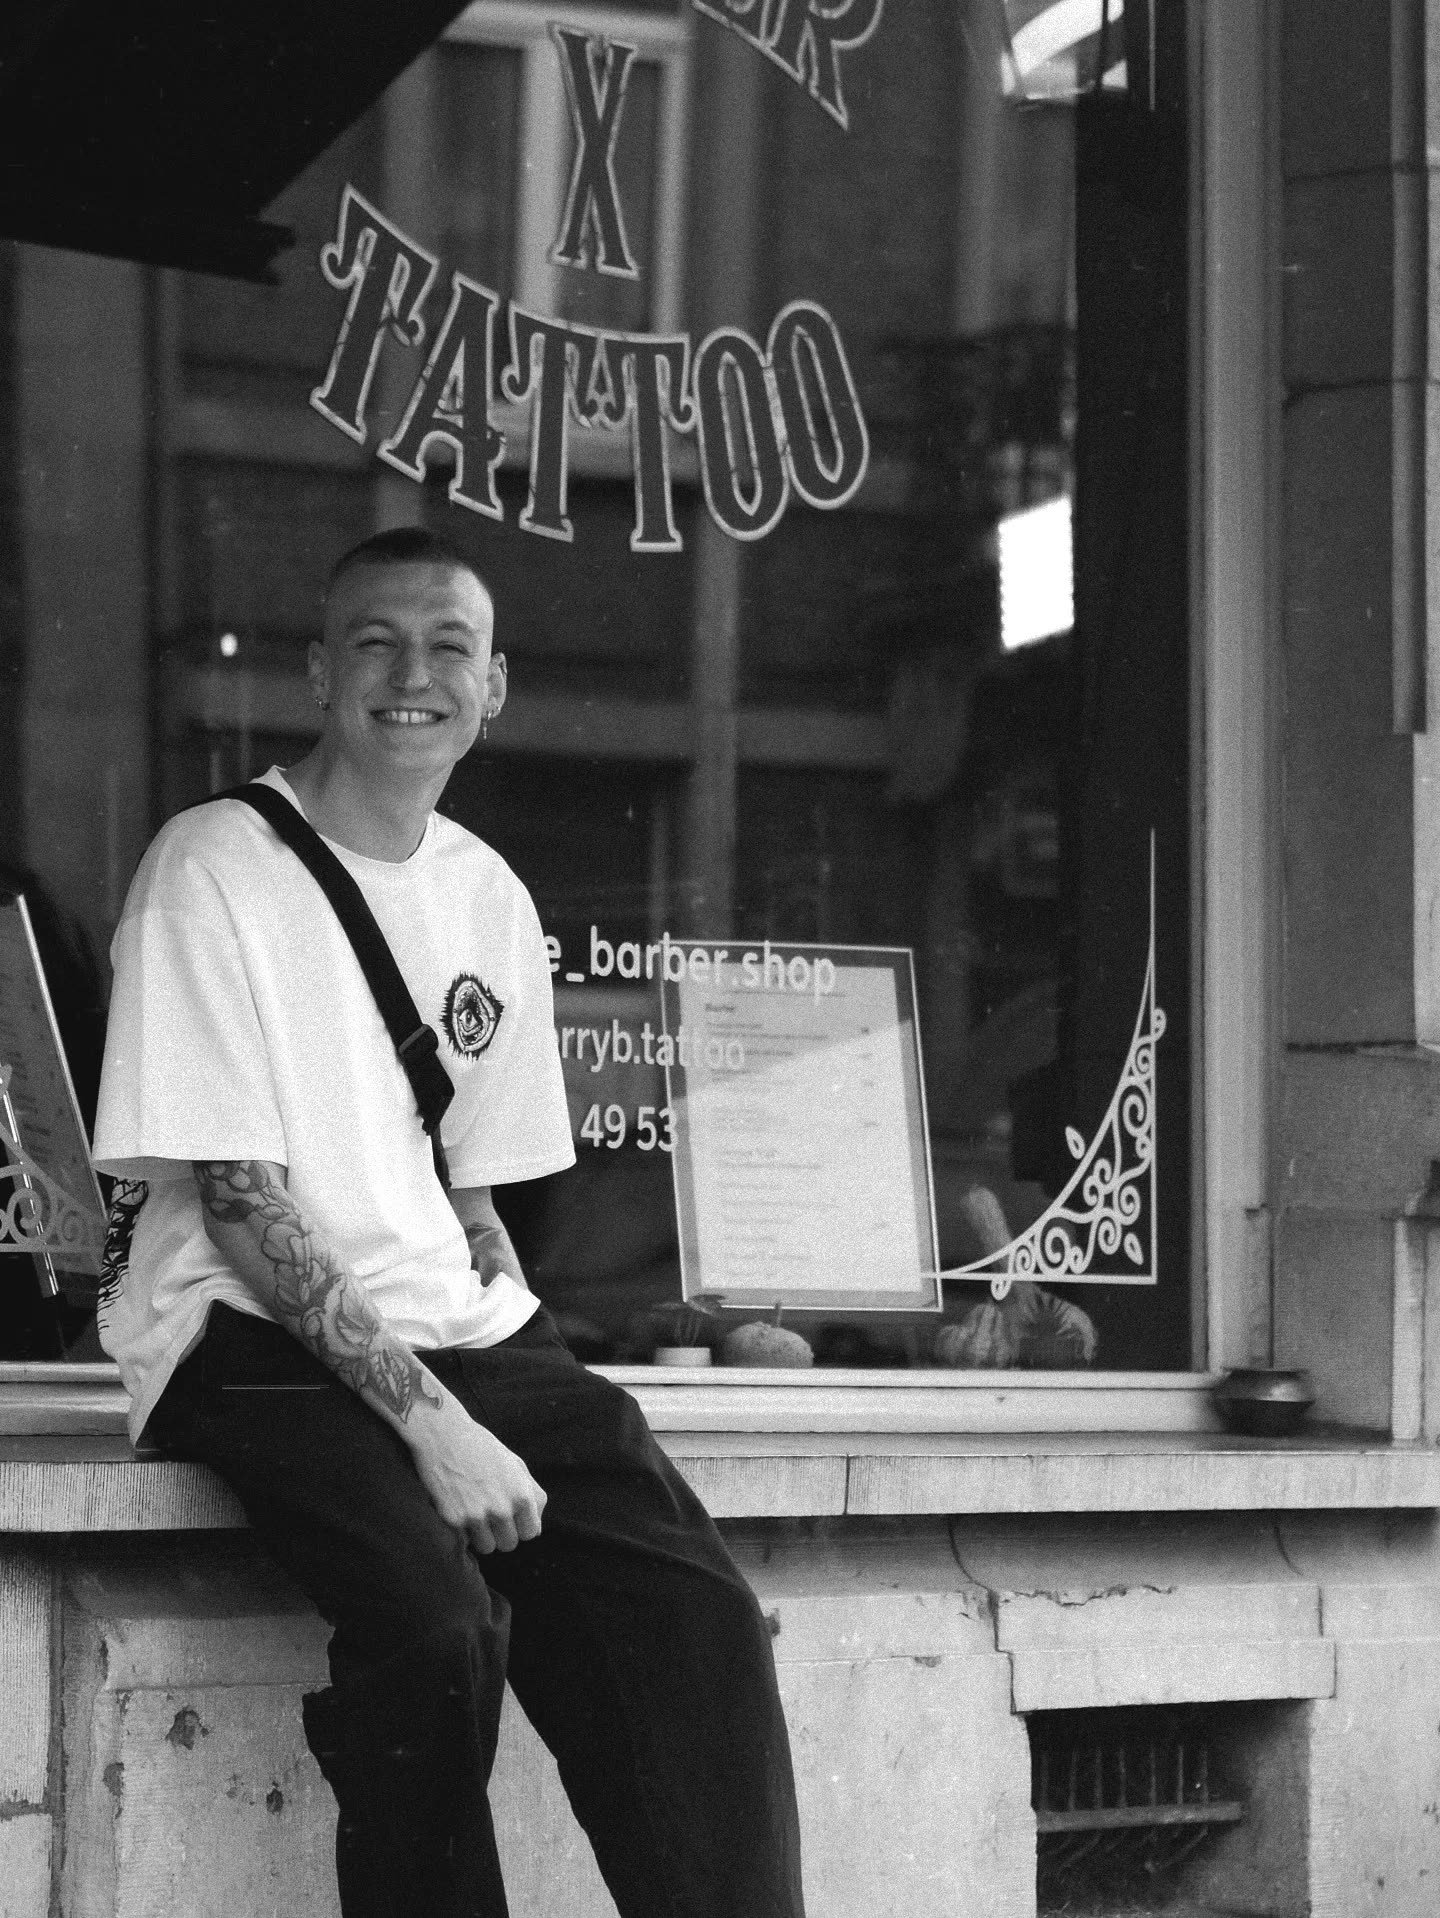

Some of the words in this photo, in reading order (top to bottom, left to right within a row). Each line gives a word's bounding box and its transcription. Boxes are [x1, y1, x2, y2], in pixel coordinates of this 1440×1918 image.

[547, 22, 640, 281] X
[309, 183, 870, 552] TATTOO
[580, 1104, 626, 1149] 49
